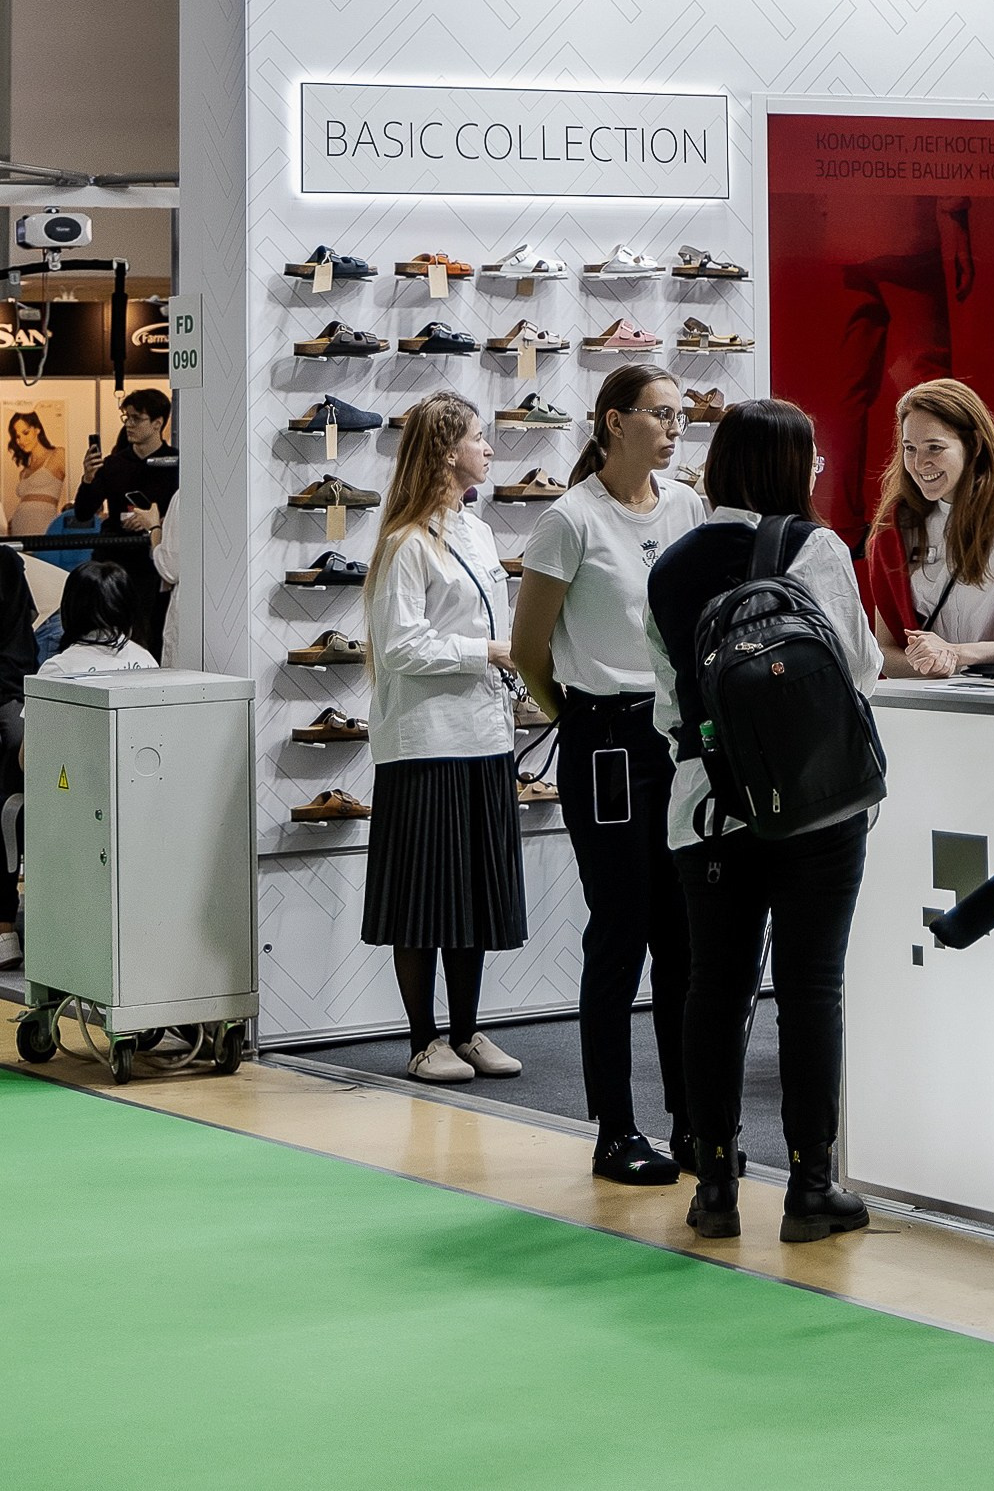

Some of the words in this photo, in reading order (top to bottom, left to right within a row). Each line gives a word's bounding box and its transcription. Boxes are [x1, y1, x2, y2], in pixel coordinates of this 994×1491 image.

[325, 120, 444, 161] BASIC
[455, 122, 707, 164] COLLECTION
[816, 132, 909, 153] КОМФОРТ,
[816, 160, 907, 179] ЗДОРОВЬЕ
[912, 162, 974, 181] ВАШИХ
[176, 314, 194, 335] FD
[173, 350, 197, 370] 090
